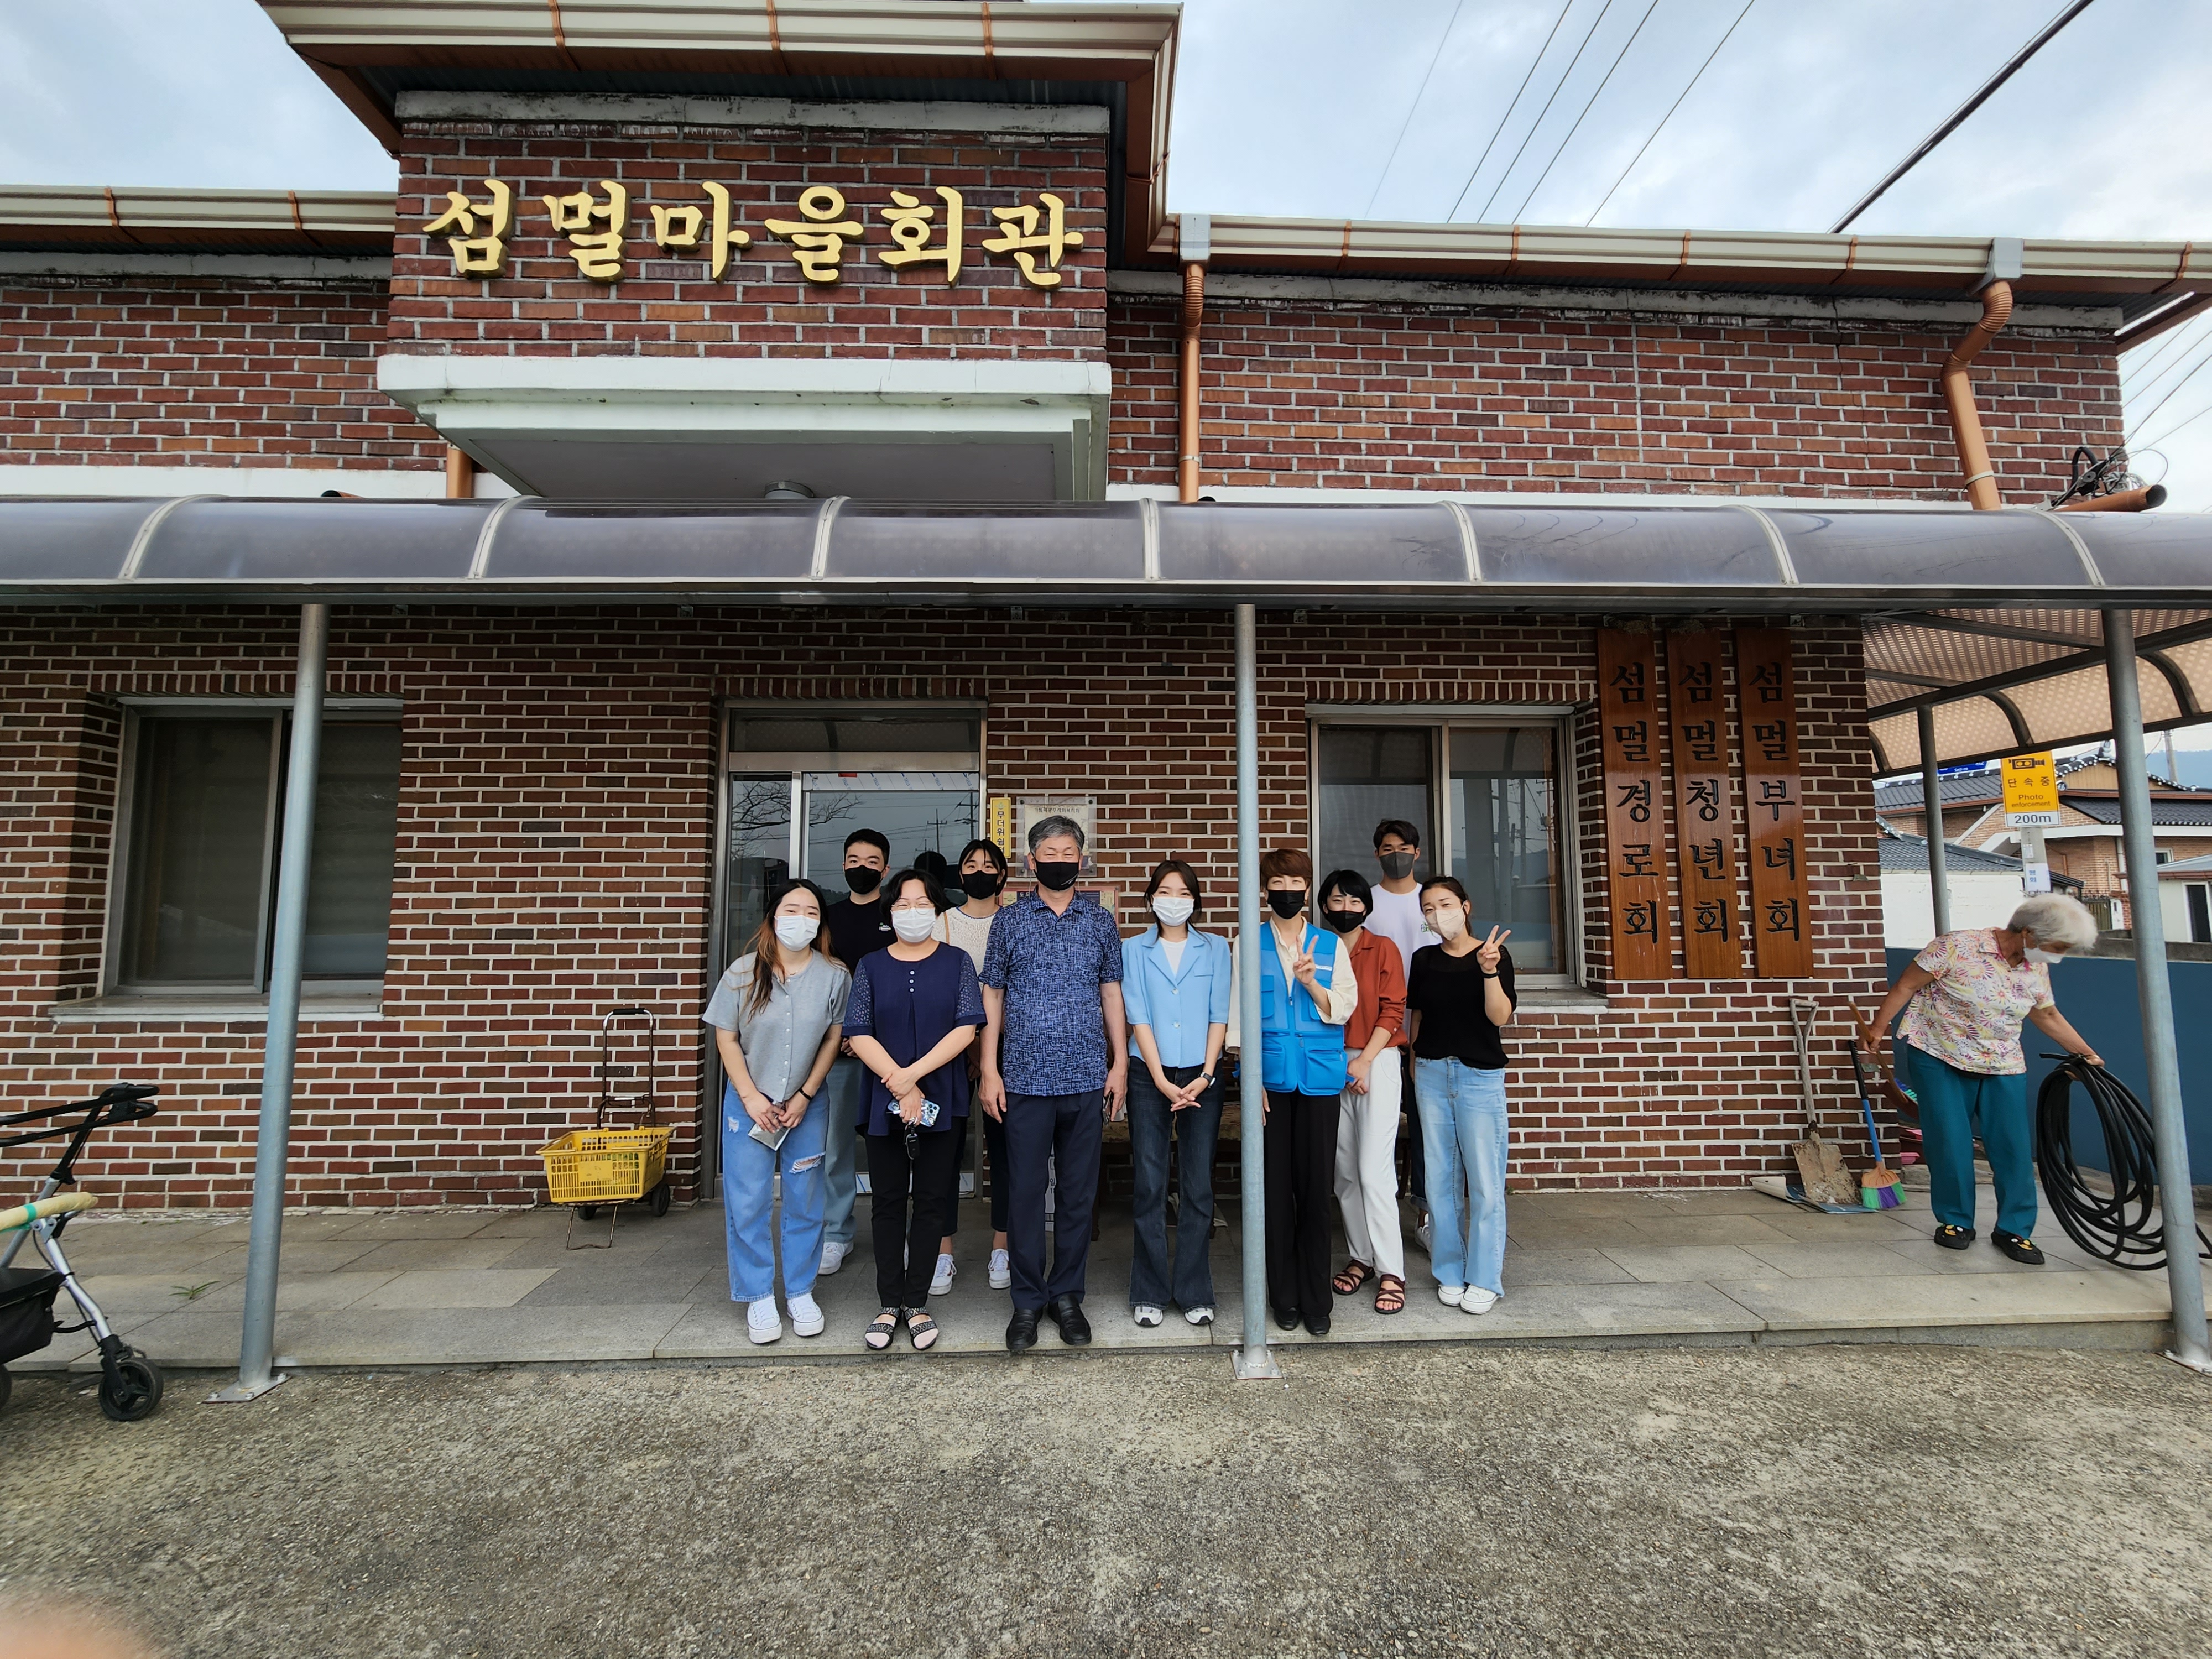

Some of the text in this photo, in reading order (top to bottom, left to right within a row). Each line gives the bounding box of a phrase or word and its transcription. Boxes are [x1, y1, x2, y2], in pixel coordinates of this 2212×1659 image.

[1610, 662, 1660, 944] 섬멀경로회
[1678, 661, 1728, 943] 섬멀청년회
[1749, 661, 1799, 942] 섬멀부녀회
[2014, 814, 2052, 825] 200m
